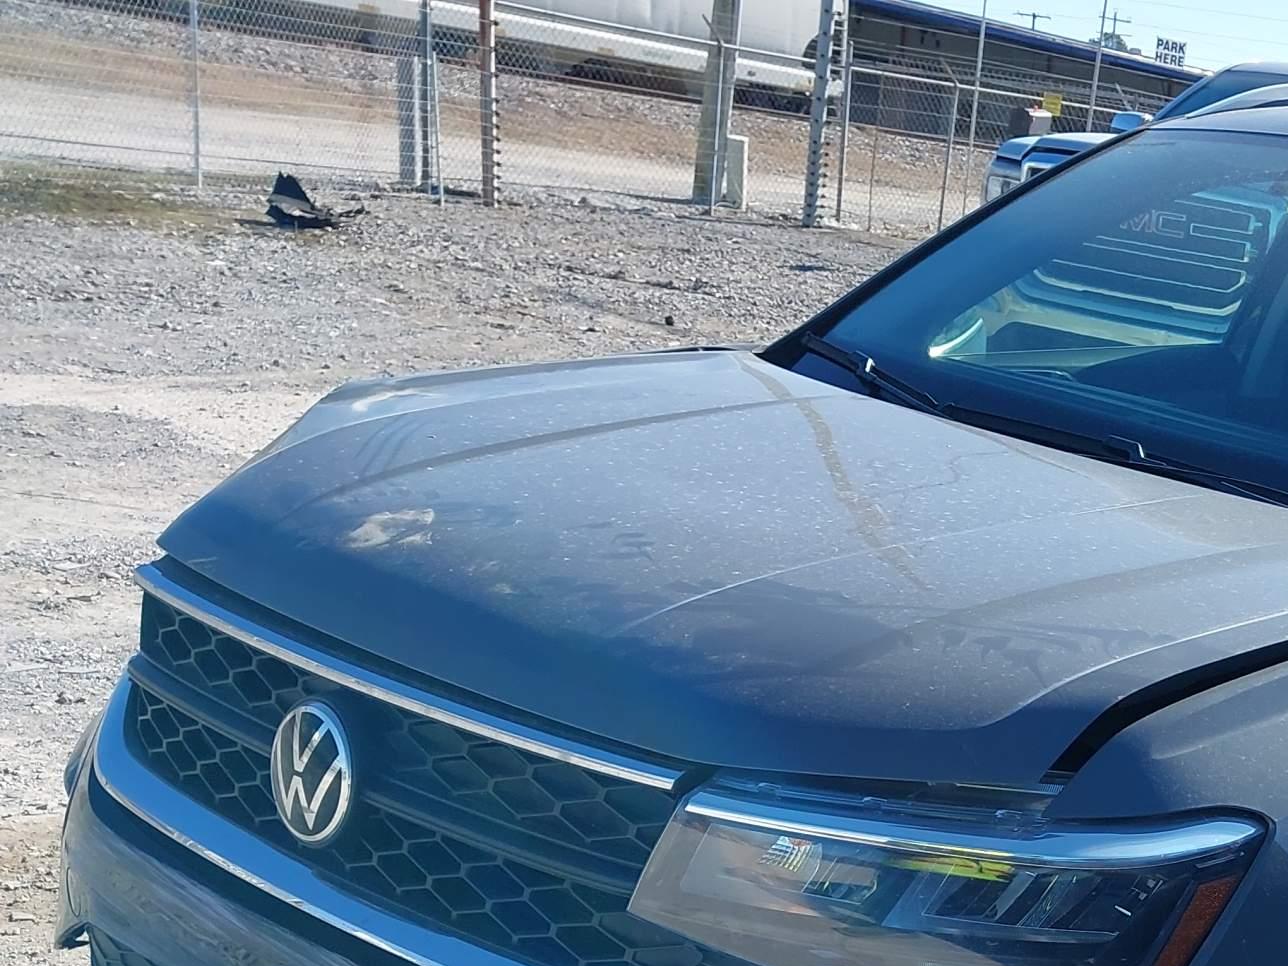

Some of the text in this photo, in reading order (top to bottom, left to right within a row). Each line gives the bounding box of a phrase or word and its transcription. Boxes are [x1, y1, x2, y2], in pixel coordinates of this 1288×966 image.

[1156, 37, 1187, 55] PARK
[1154, 51, 1185, 68] HERE
[1120, 209, 1186, 239] MC
